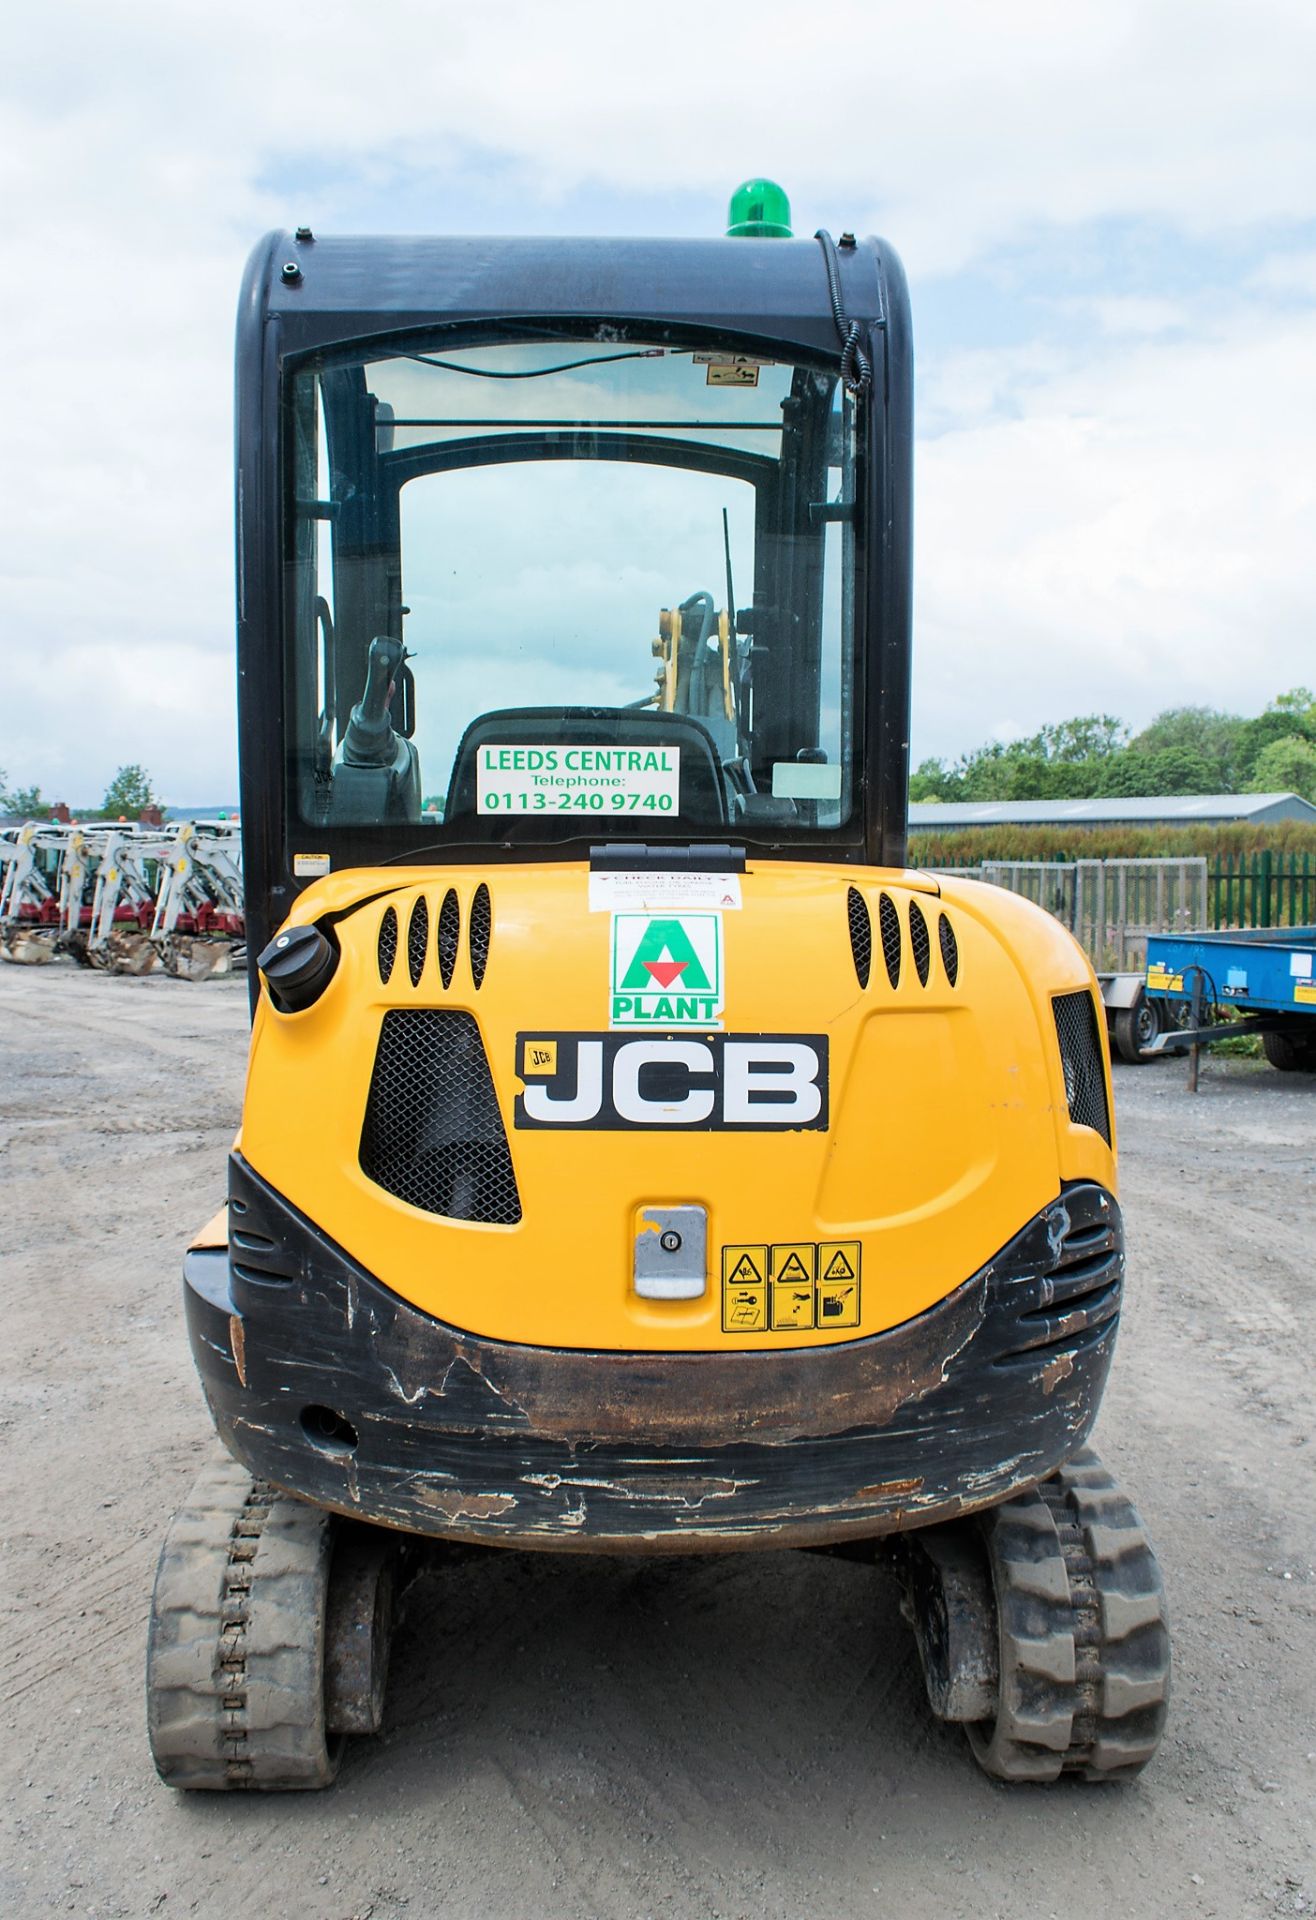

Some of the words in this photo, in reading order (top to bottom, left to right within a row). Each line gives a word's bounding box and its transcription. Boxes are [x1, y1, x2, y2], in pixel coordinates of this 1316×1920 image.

[485, 750, 558, 771] LEEDS
[564, 751, 673, 772] CENTRAL
[531, 775, 626, 789] Telephone:
[484, 793, 604, 810] 0113-240
[611, 793, 673, 811] 9740
[620, 919, 712, 989] A
[612, 997, 719, 1020] PLANT
[533, 1050, 551, 1066] JCB
[523, 1040, 822, 1123] JCB
